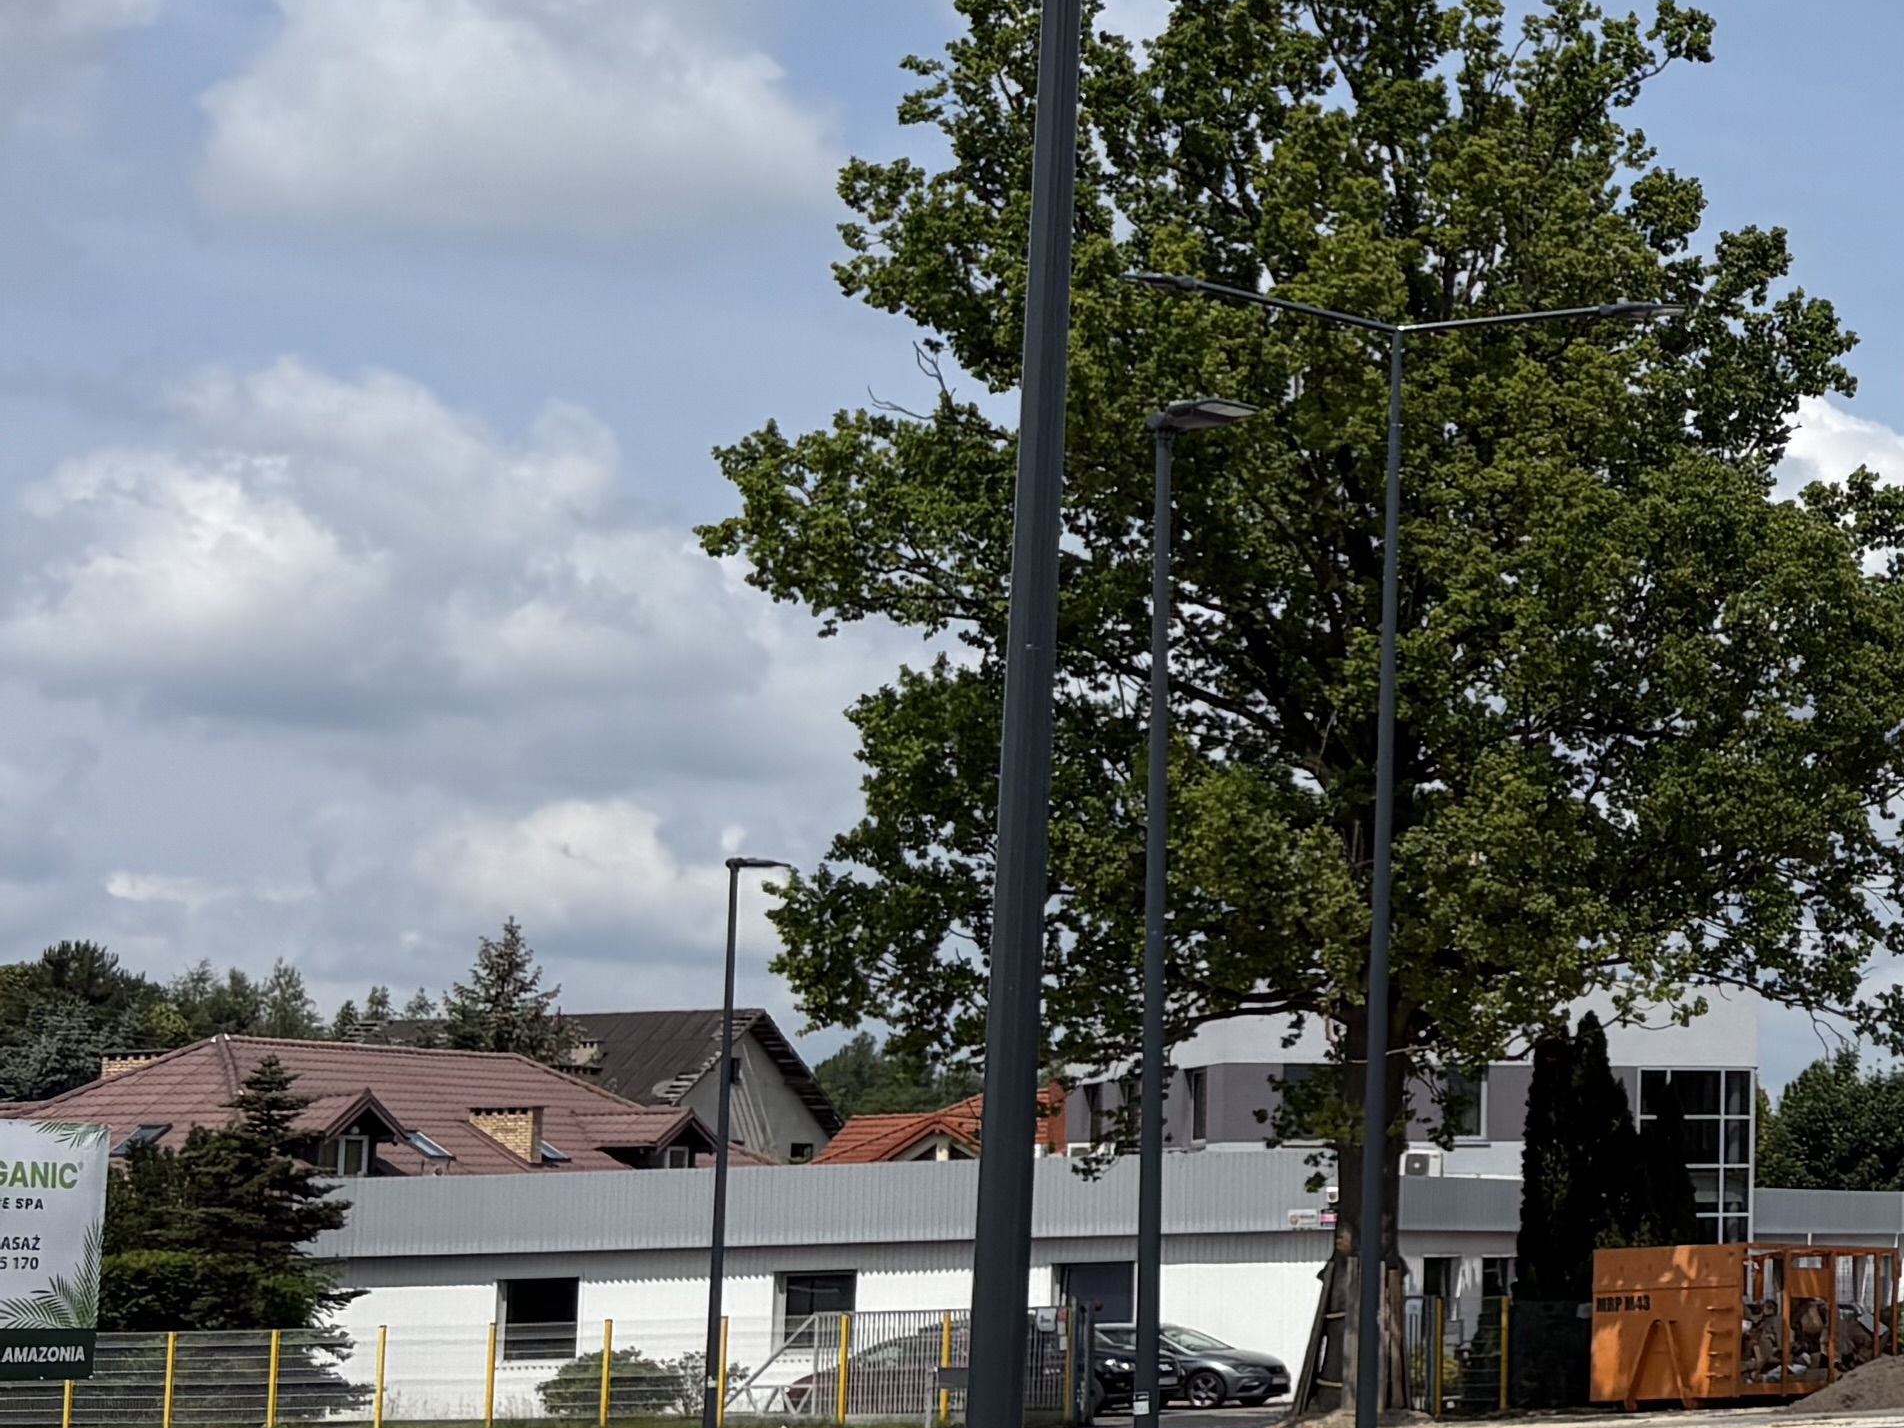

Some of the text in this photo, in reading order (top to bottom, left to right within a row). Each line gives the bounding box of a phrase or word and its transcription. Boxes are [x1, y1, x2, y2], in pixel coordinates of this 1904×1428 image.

[15, 1198, 44, 1210] SPA
[12, 1256, 39, 1270] 170
[1, 1346, 85, 1363] AMAZONIA
